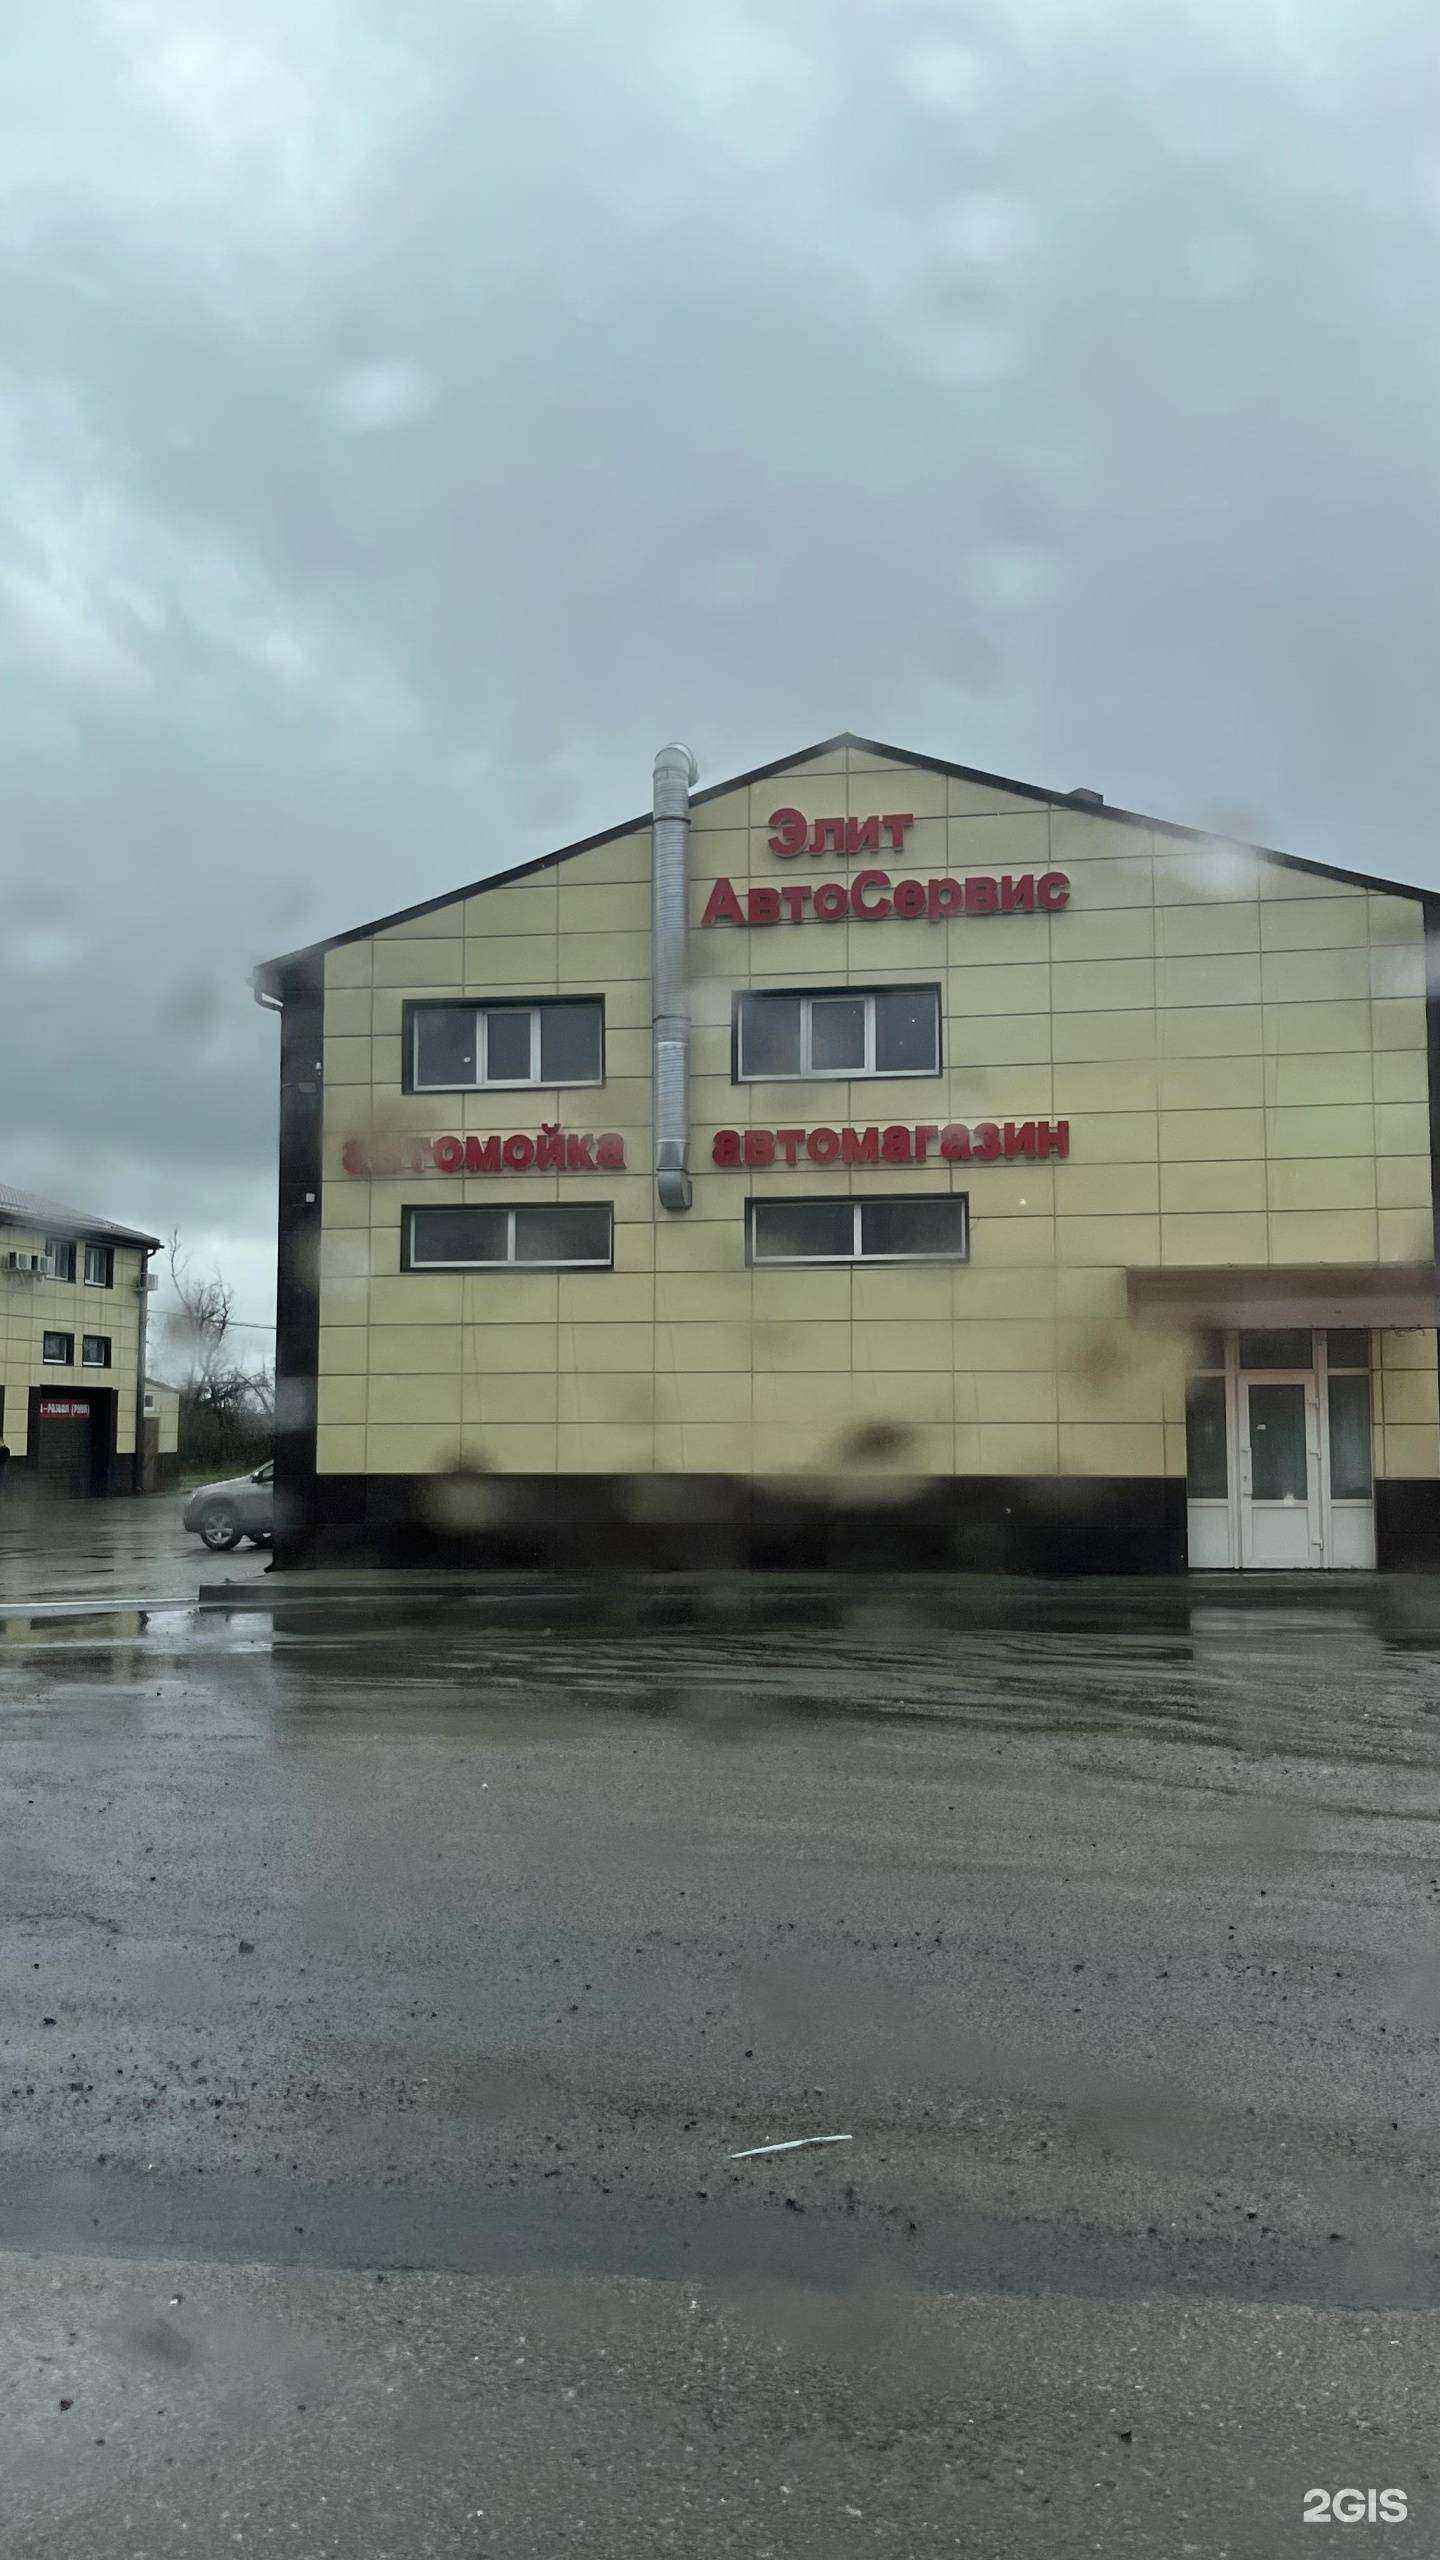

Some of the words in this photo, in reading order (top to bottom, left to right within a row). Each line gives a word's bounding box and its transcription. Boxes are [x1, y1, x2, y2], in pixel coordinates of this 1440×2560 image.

[768, 807, 914, 858] Элит
[702, 870, 1071, 926] АвтоСервис
[712, 1120, 1070, 1167] автомагазин
